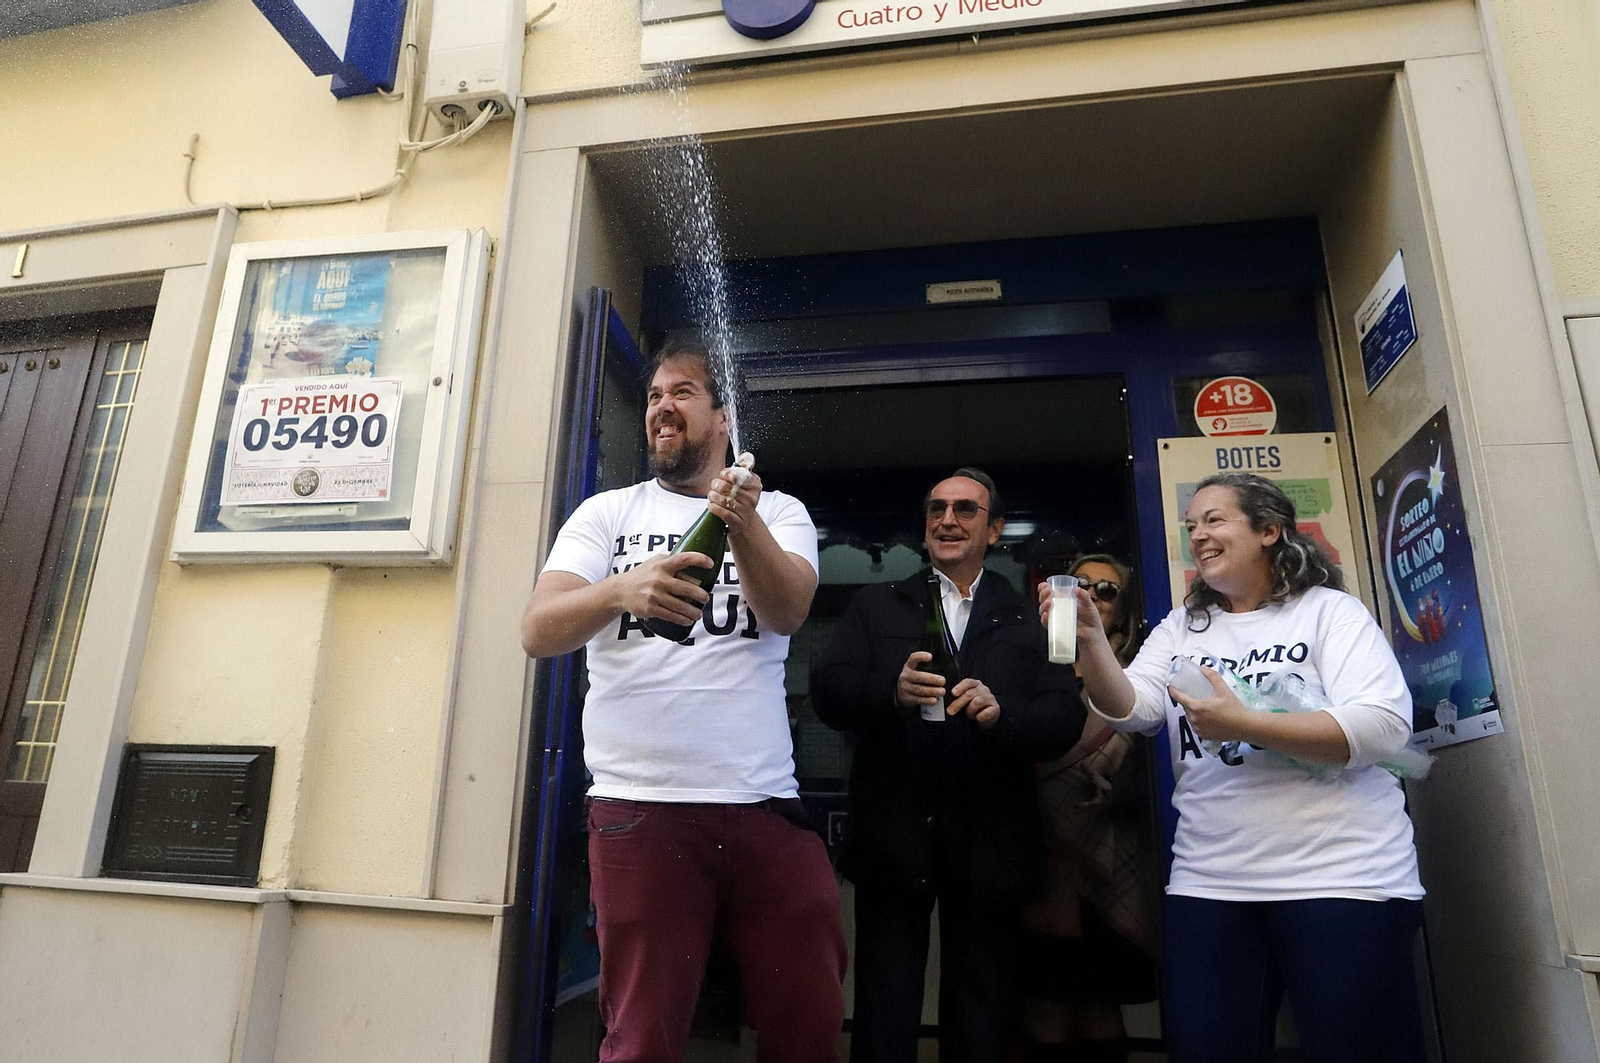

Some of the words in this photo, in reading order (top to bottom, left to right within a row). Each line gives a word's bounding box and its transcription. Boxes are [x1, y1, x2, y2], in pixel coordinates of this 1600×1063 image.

[837, 5, 923, 29] Cuatro
[934, 3, 948, 23] y
[294, 384, 328, 392] VENDIDO
[328, 381, 348, 390] AQUÍ
[1209, 383, 1254, 407] +18
[277, 392, 379, 416] PREMIO
[243, 413, 388, 452] 05490
[1215, 445, 1281, 470] BOTES
[1400, 498, 1430, 532] SORTEO
[1396, 550, 1413, 579] EL
